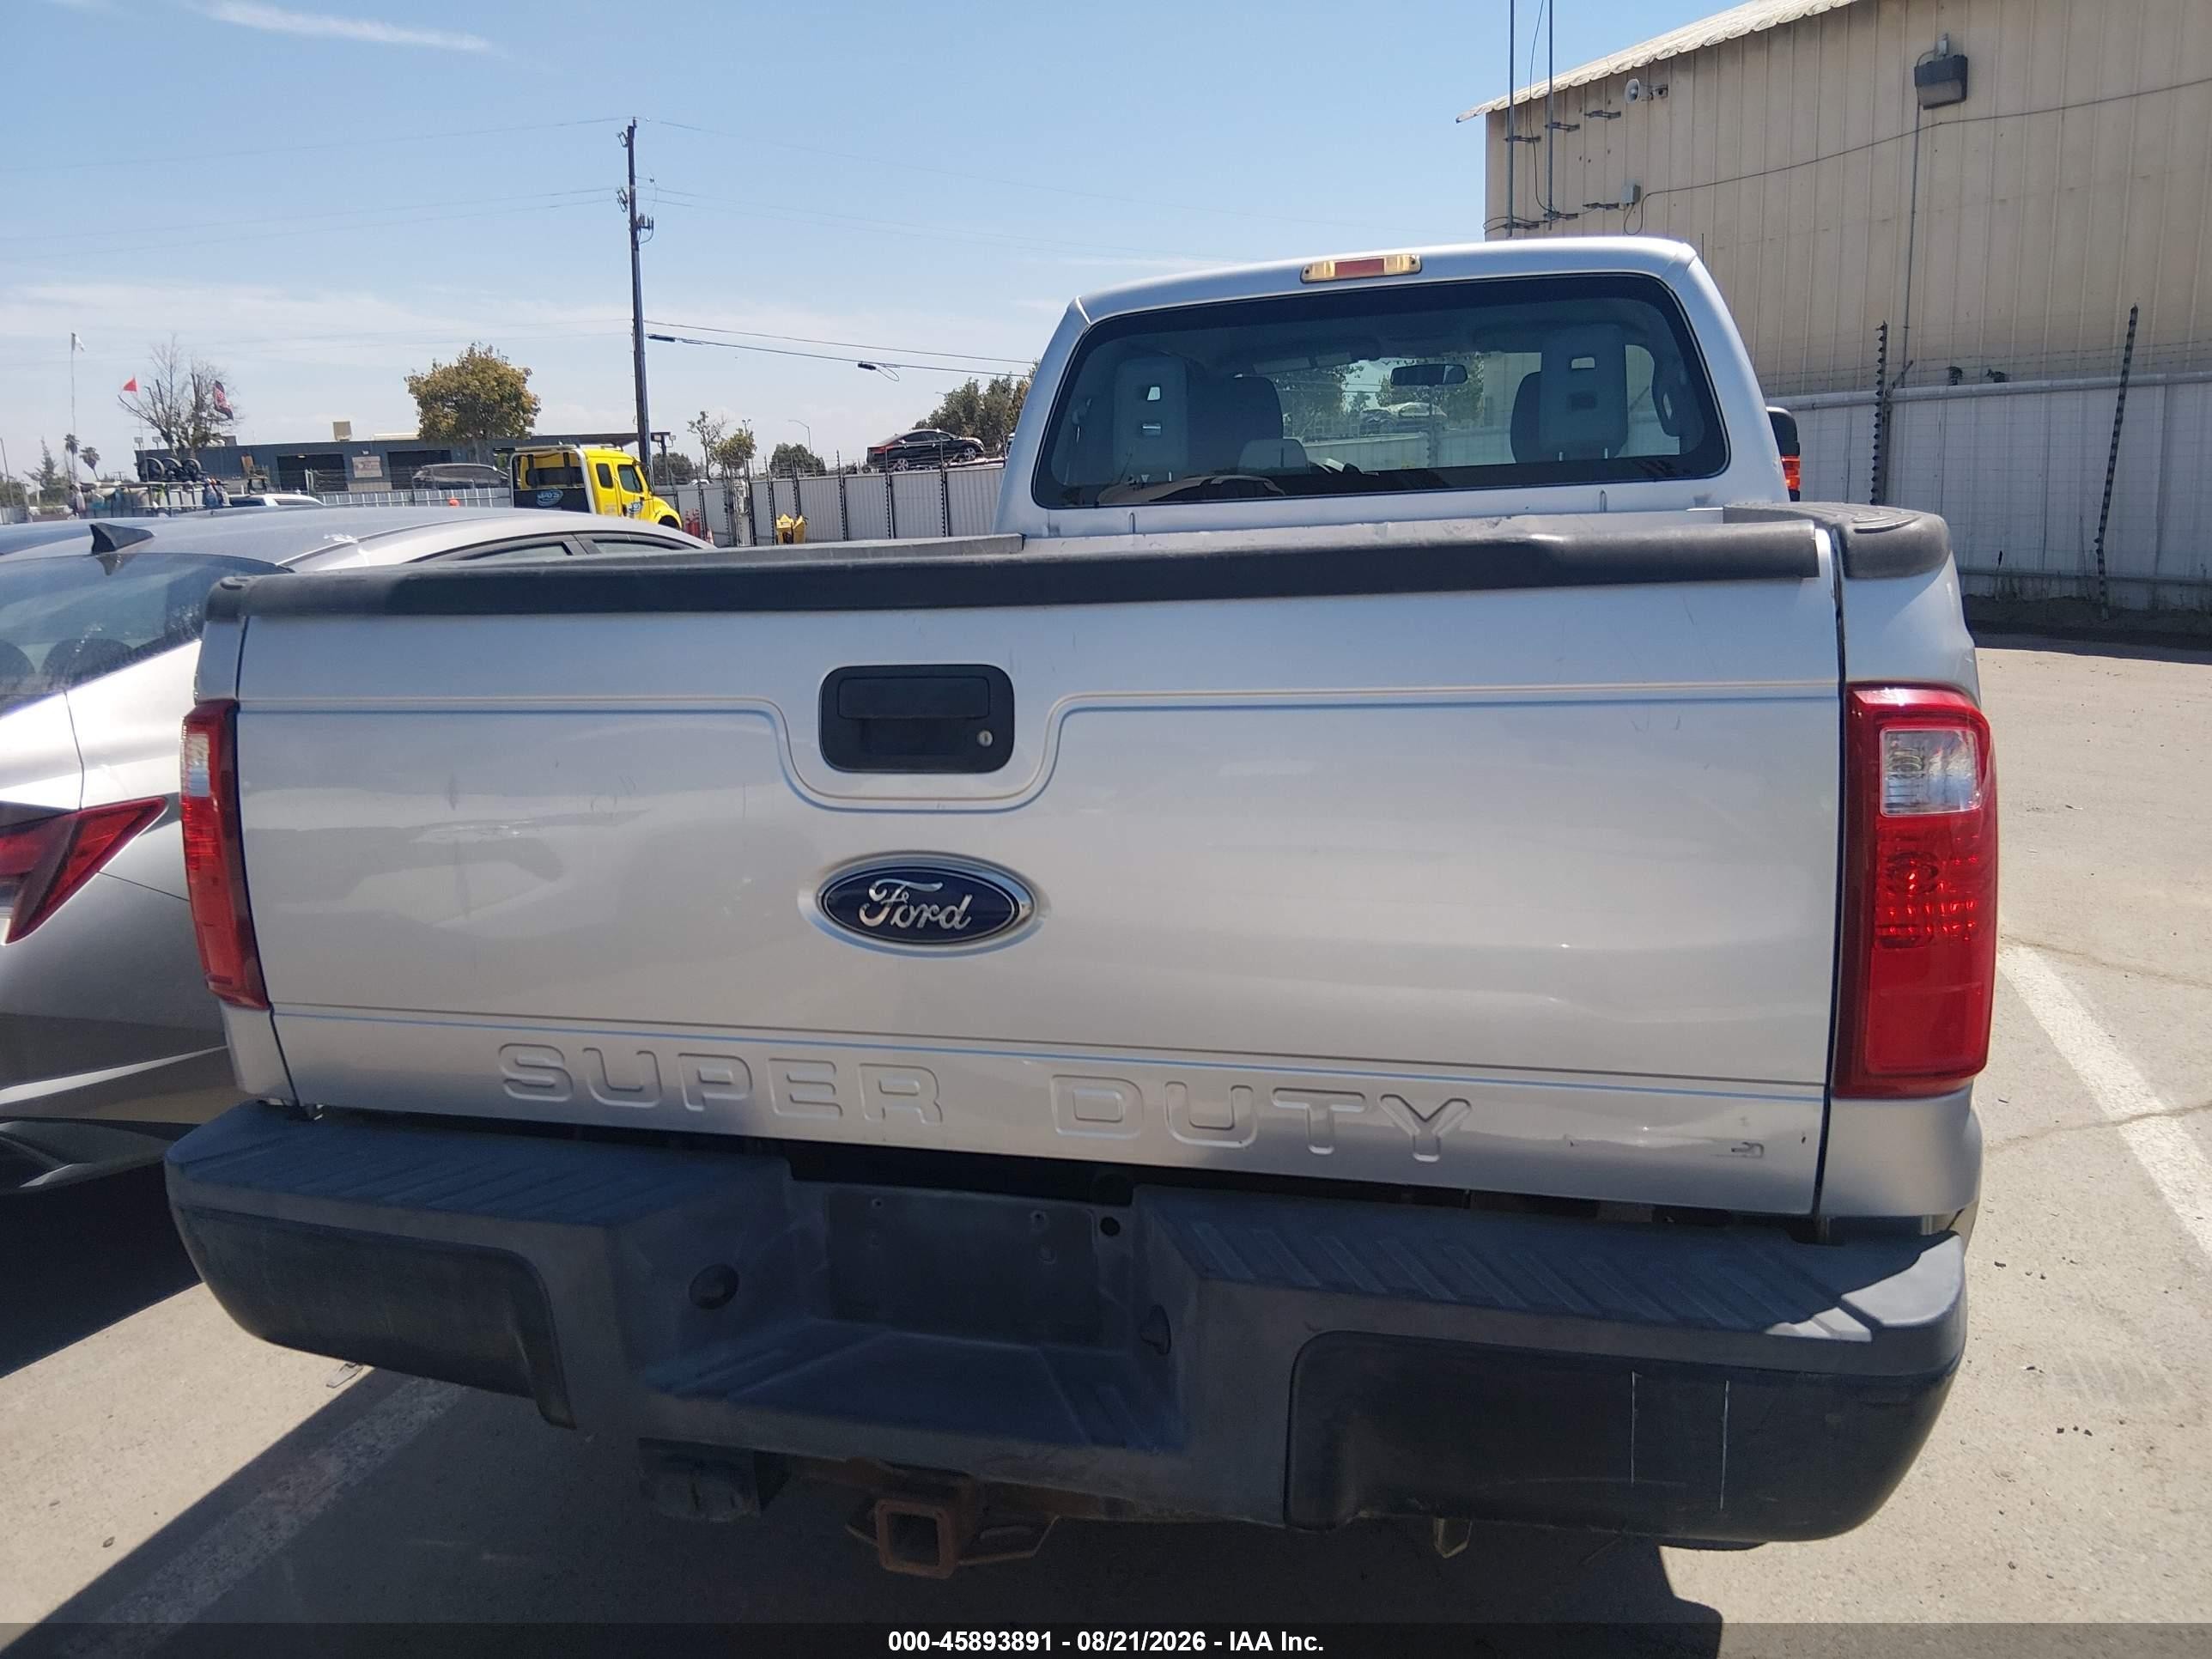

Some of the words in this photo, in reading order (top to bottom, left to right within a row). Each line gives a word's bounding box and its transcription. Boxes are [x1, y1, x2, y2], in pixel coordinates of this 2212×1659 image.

[859, 878, 973, 930] Ford
[498, 1042, 943, 1124] SUPER
[1050, 1073, 1472, 1163] DUTY
